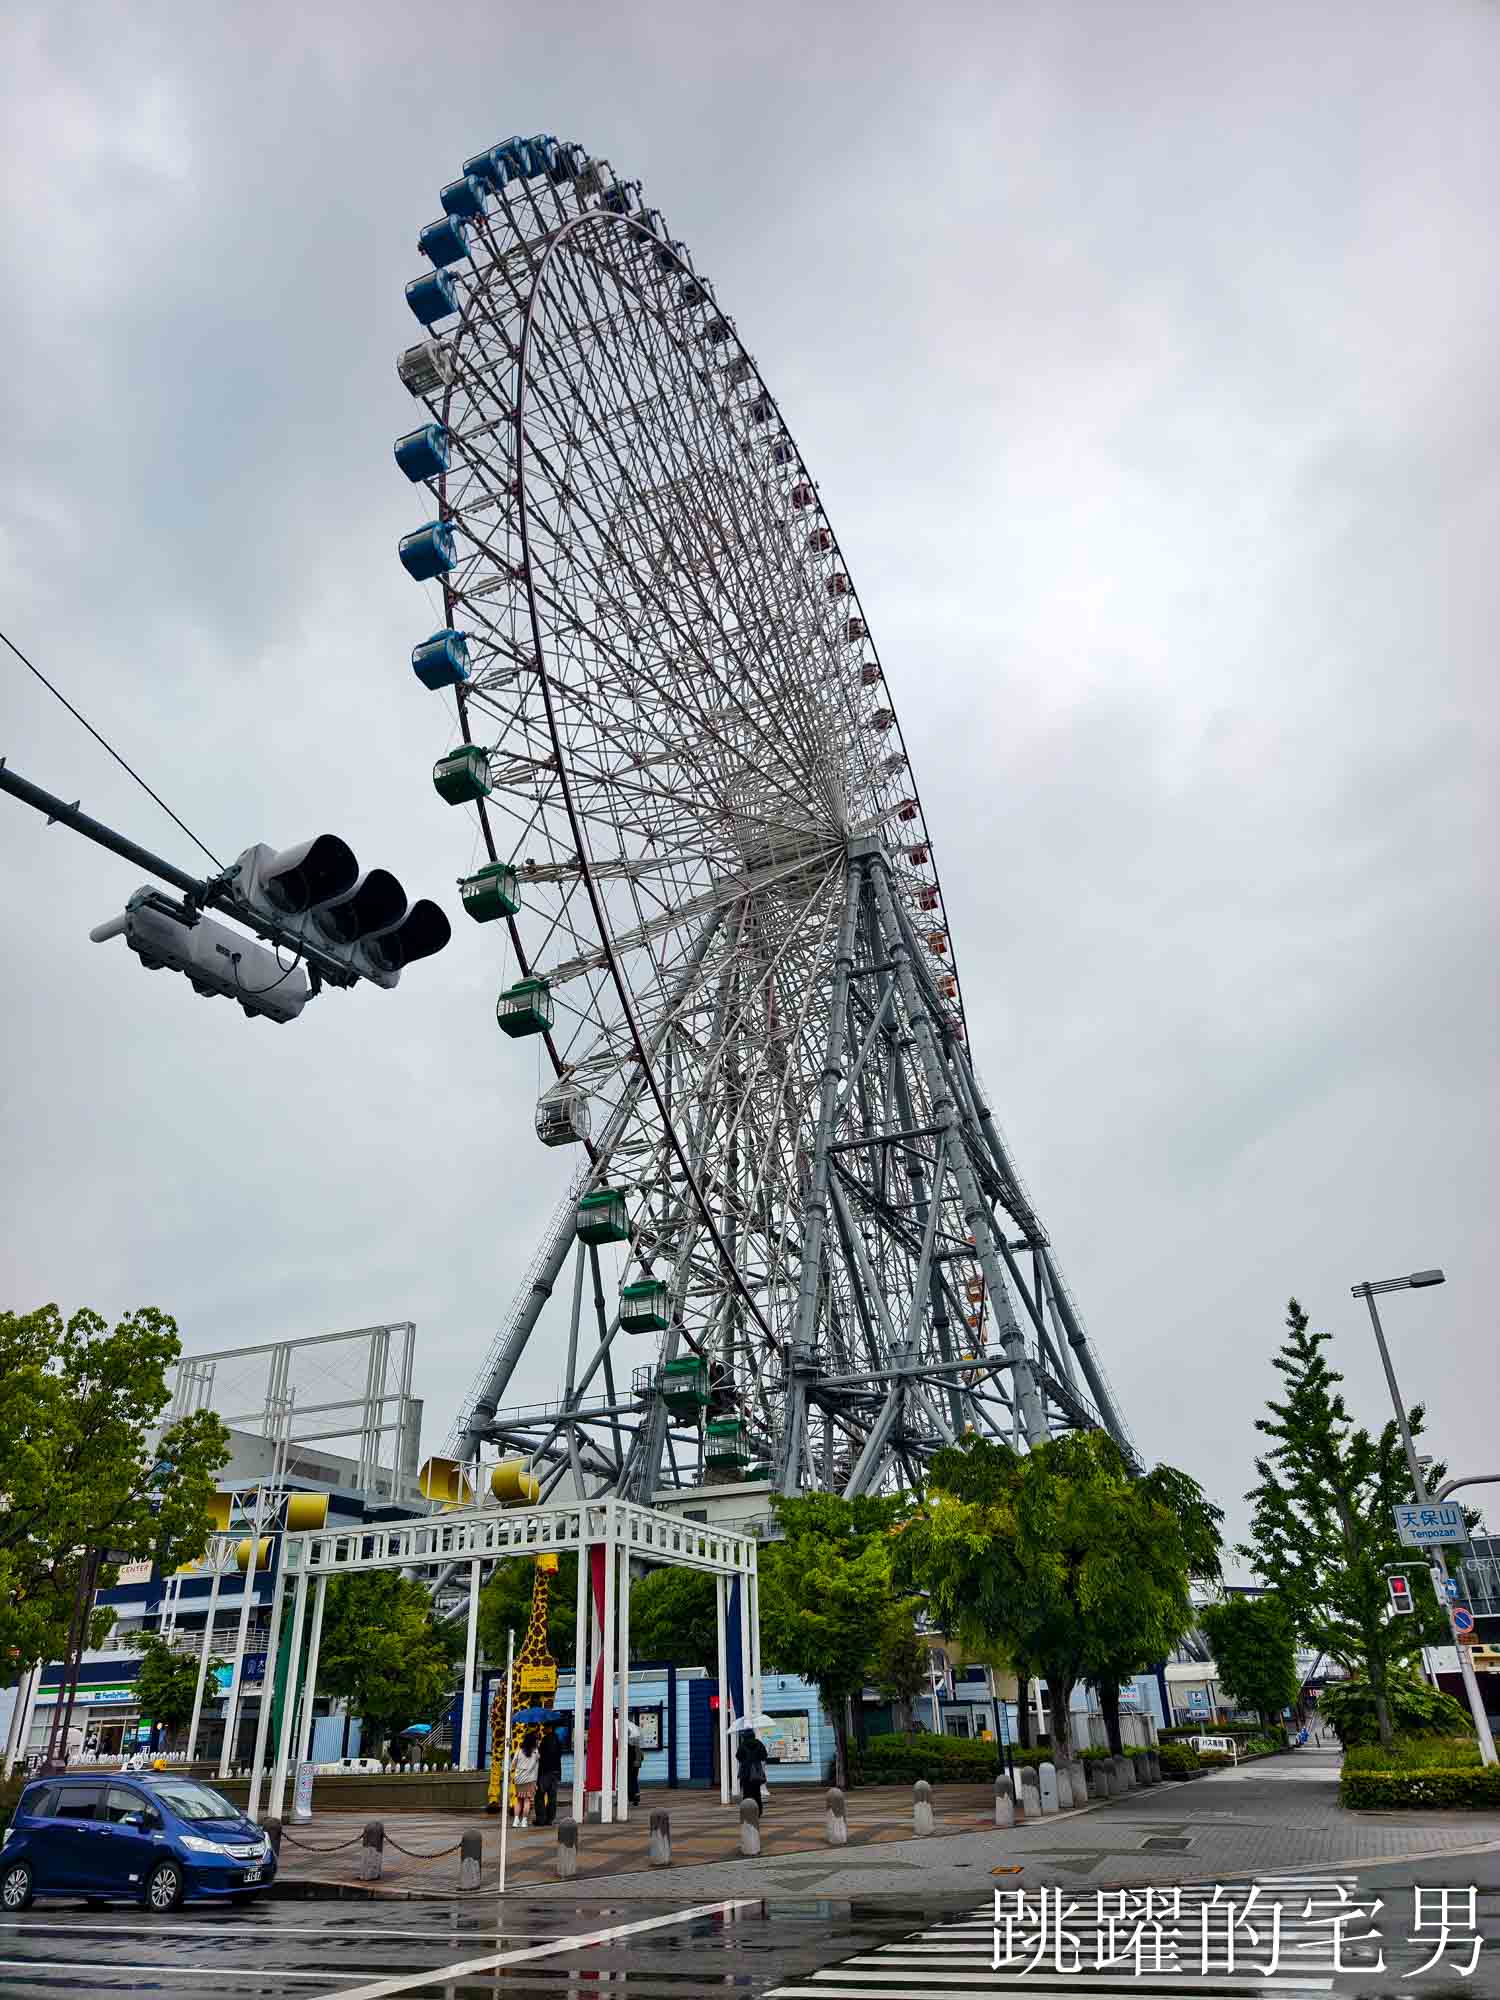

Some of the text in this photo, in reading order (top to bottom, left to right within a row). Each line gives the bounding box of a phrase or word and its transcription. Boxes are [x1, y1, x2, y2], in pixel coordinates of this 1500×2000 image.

[1401, 1509, 1457, 1528] 天保山
[1409, 1529, 1457, 1539] Tenpozan
[121, 1562, 150, 1574] CENTER
